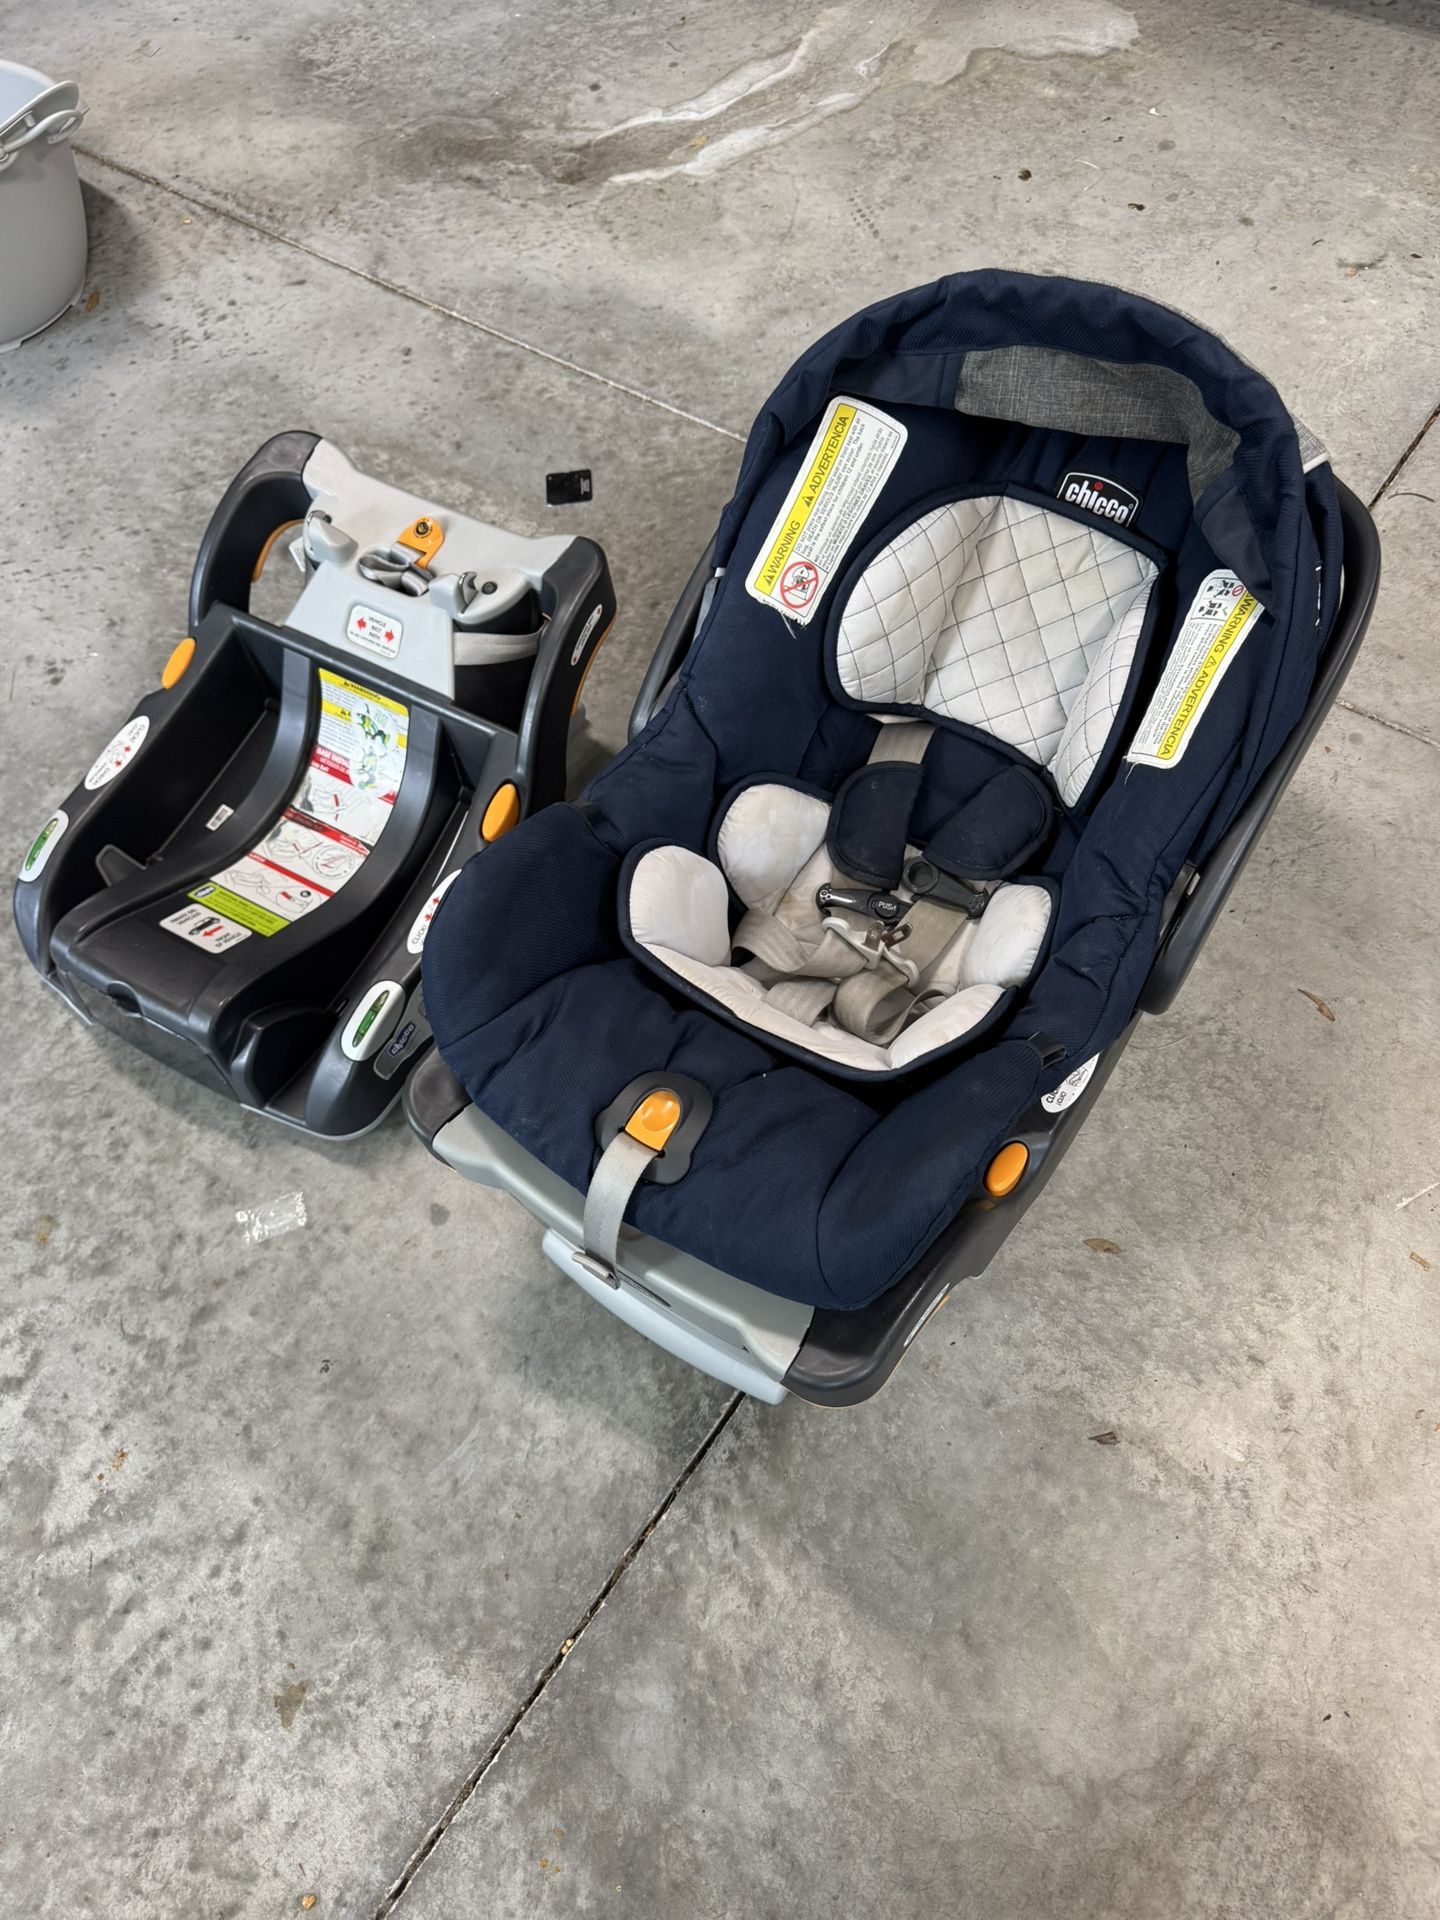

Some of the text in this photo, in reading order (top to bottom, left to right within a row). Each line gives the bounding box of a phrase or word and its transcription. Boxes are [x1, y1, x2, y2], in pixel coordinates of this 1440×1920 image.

[767, 413, 849, 574] WARNING ADVERTENCIA
[1213, 595, 1253, 654] WARNING
[1160, 670, 1209, 757] ADVERTENCIA
